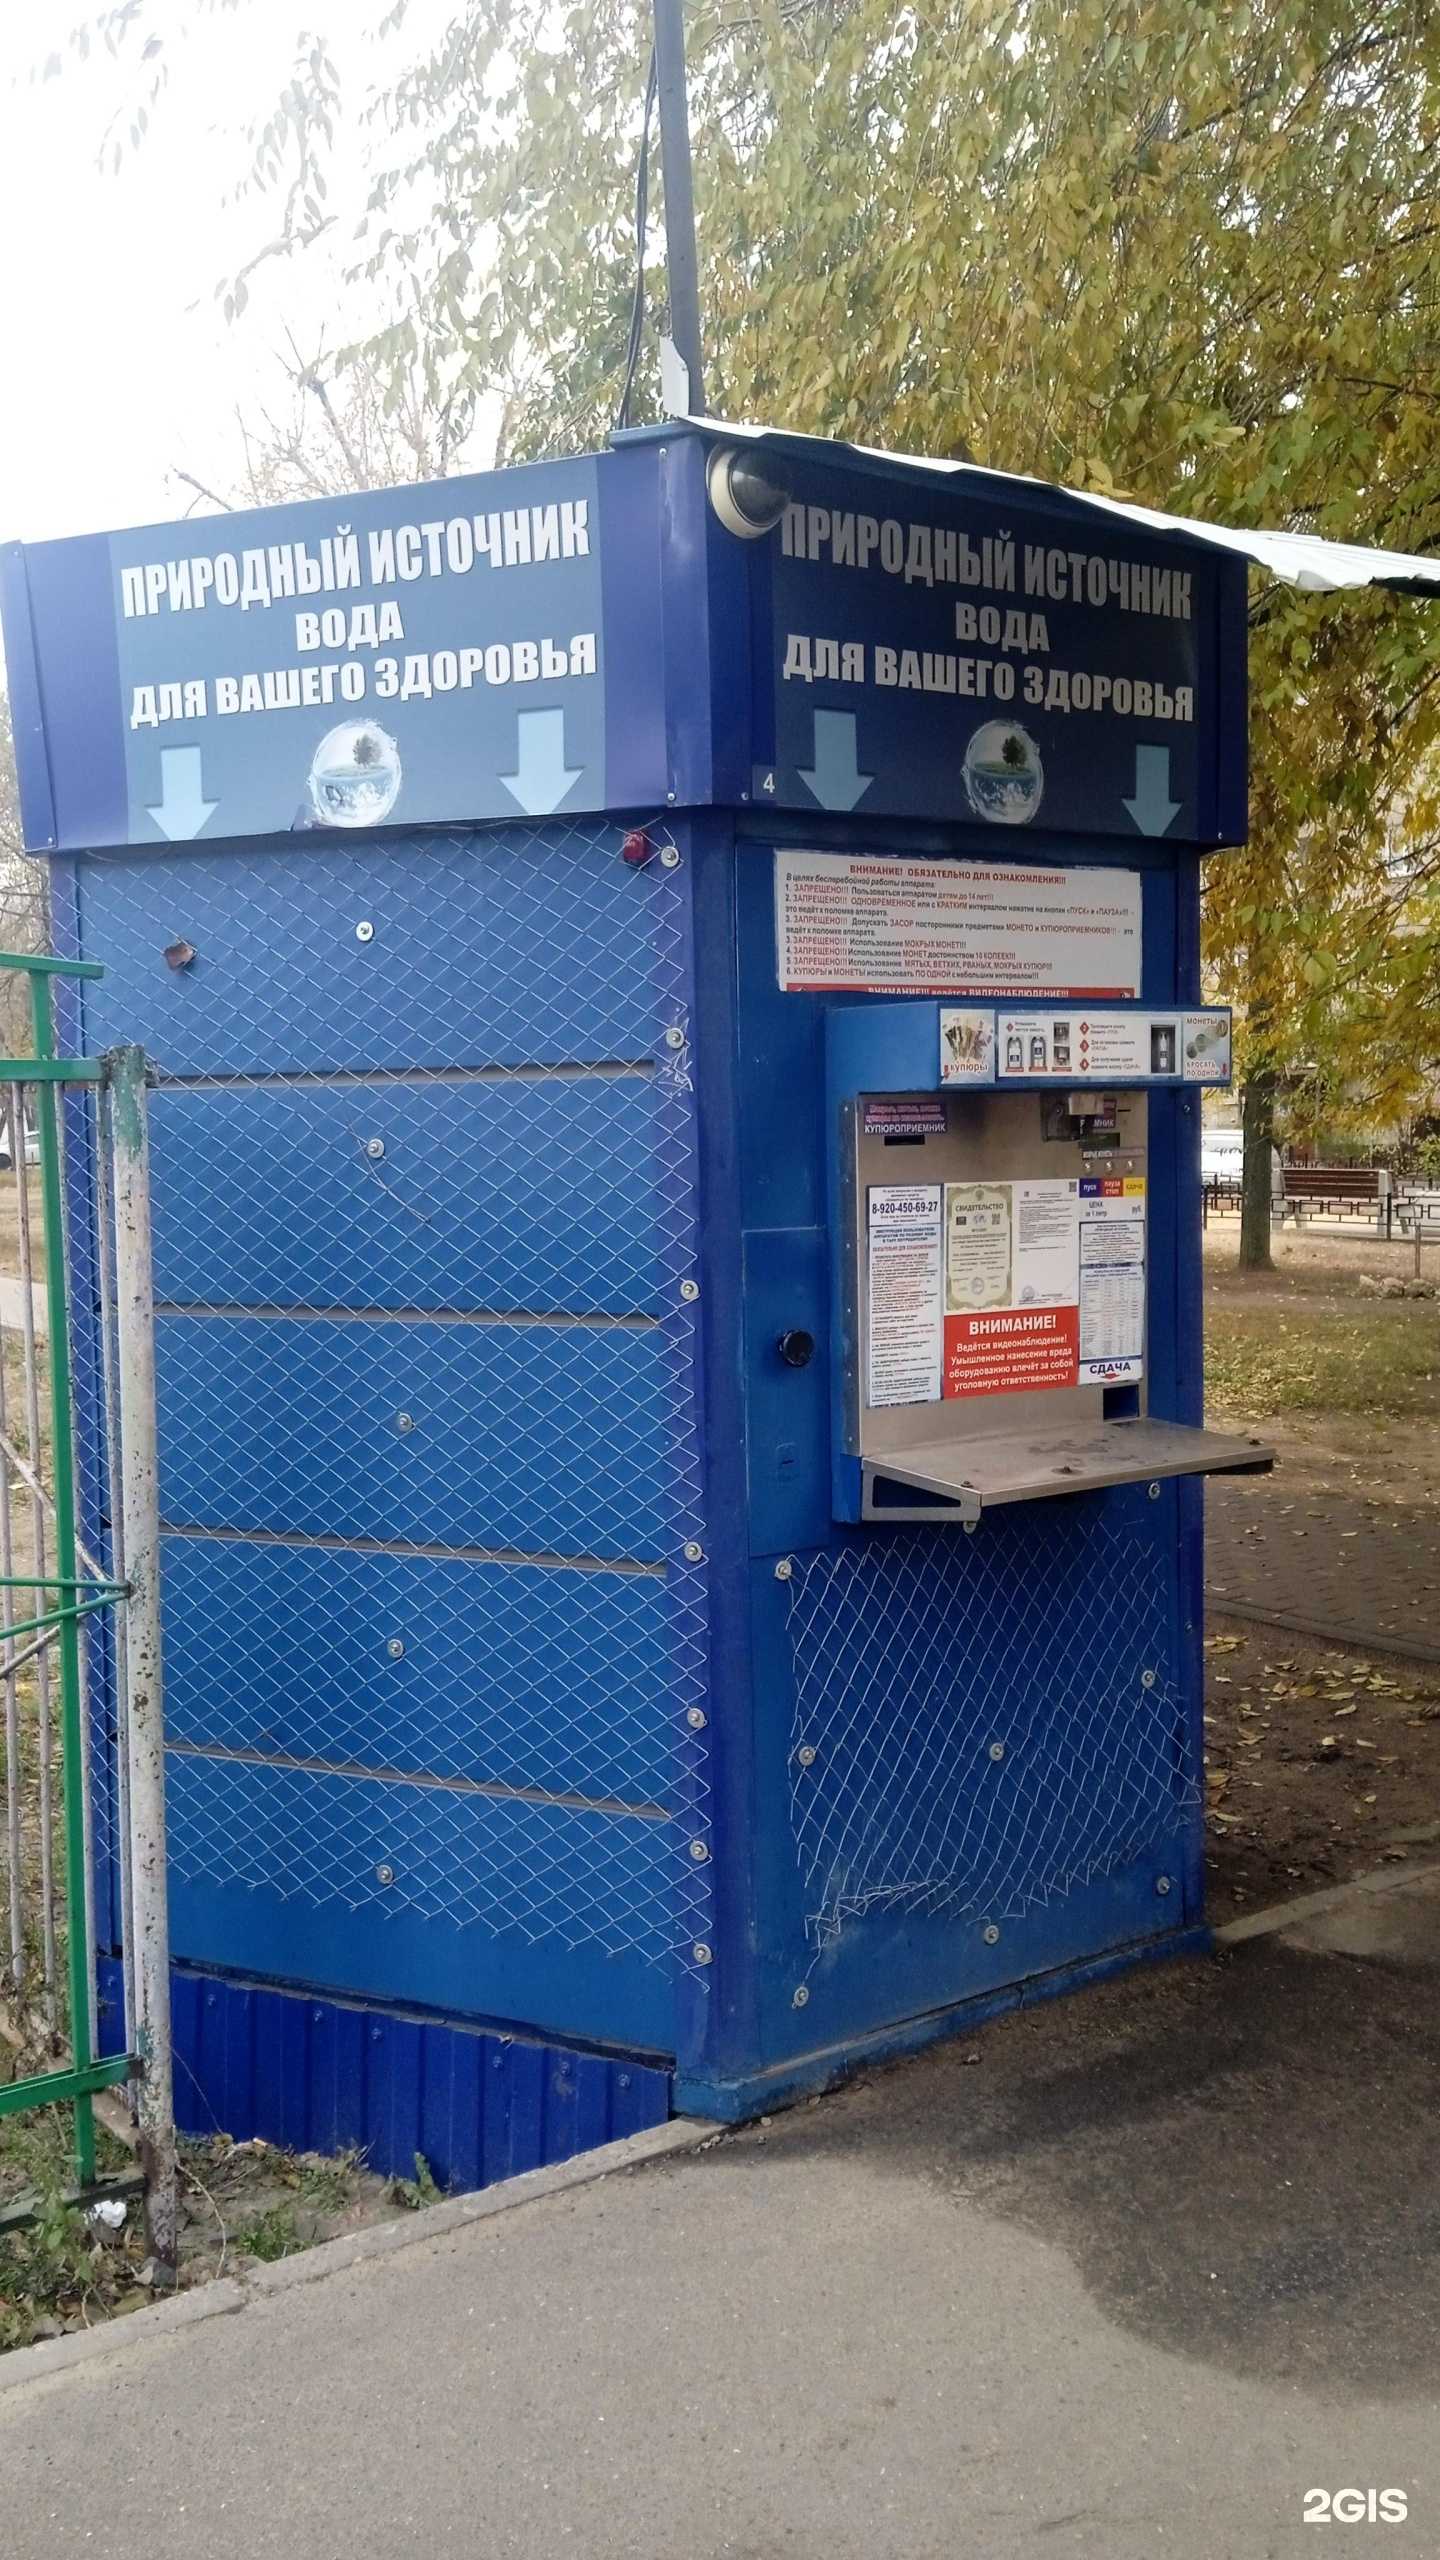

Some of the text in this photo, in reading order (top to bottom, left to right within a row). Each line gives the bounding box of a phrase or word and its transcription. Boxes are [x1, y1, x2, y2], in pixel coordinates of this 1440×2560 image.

[121, 499, 590, 618] ПРИРОДНЫЙ ИСТОЧНИК
[781, 504, 1192, 620] ПРИРОДНЫЙ ИСТОЧНИК
[295, 600, 405, 653] ВОДА
[955, 602, 1050, 652] ВОДА
[130, 633, 596, 729] ДЛЯ ВАШЕГО ЗДОРОВЬЯ
[783, 634, 1194, 722] ДЛЯ ВАШЕГО ЗДОРОВЬЯ
[763, 774, 775, 794] 4
[786, 873, 792, 881] В
[793, 874, 814, 884] целях
[815, 873, 870, 887] бесперебойной
[871, 878, 900, 888] работы
[850, 864, 903, 877] ВНИМАНИЕ!
[907, 868, 971, 881] ОБЯЗАТЕЛЬНО
[973, 872, 991, 882] ДЛЯ
[794, 884, 849, 894] ЗАПРЕЩЕНО!!!
[851, 887, 901, 898] Пользоваться
[901, 890, 938, 899] аппаратом
[959, 893, 968, 902] до
[968, 893, 976, 901] 14
[794, 895, 848, 905] ЗАПРЕЩЕНО!!!
[851, 898, 916, 908] ОДНОВРЕМЕННОЕ
[937, 902, 968, 911] КРАТКИМ
[969, 904, 1008, 913] интервалом
[794, 916, 848, 926] ЗАПРЕЩЕНО!!!
[851, 919, 889, 929] Допускать
[890, 920, 914, 929] ЗАСОР
[1005, 923, 1033, 933] МОНЕТО
[794, 936, 847, 946] ЗАПРЕЩЕНО!!!
[850, 939, 903, 948] Использование
[905, 941, 935, 950] МОКРЫХ
[794, 947, 847, 957] ЗАПРЕЩЕНО!!!
[848, 949, 901, 958] Использование
[903, 949, 927, 959] МОНЕТ
[928, 952, 975, 960] достоинством
[976, 952, 983, 960] 10
[794, 957, 847, 967] ЗАПРЕЩЕНО!!!
[848, 959, 902, 968] Использование
[994, 962, 1023, 970] МОКРЫХ
[833, 969, 865, 977] МОНЕТЫ
[866, 971, 914, 979] использовать
[915, 970, 925, 979] ПО
[865, 1123, 946, 1133] КУПЮРОПРИЕМНИК
[872, 1202, 938, 1214] 8-920-450-69-27
[955, 1203, 1004, 1212] СВИДЕТЕЛЬСТВО
[969, 1315, 1057, 1335] ВНИМАНИЕ!
[957, 1334, 1067, 1353] Ведётся видеонаблюдение!
[951, 1347, 1072, 1366] Умышленное нанесение вреда
[949, 1359, 1074, 1379] оборудованию влечёт за собой
[1090, 1361, 1131, 1374] СДАЧА
[954, 1372, 1069, 1393] уголовную ответственность!
